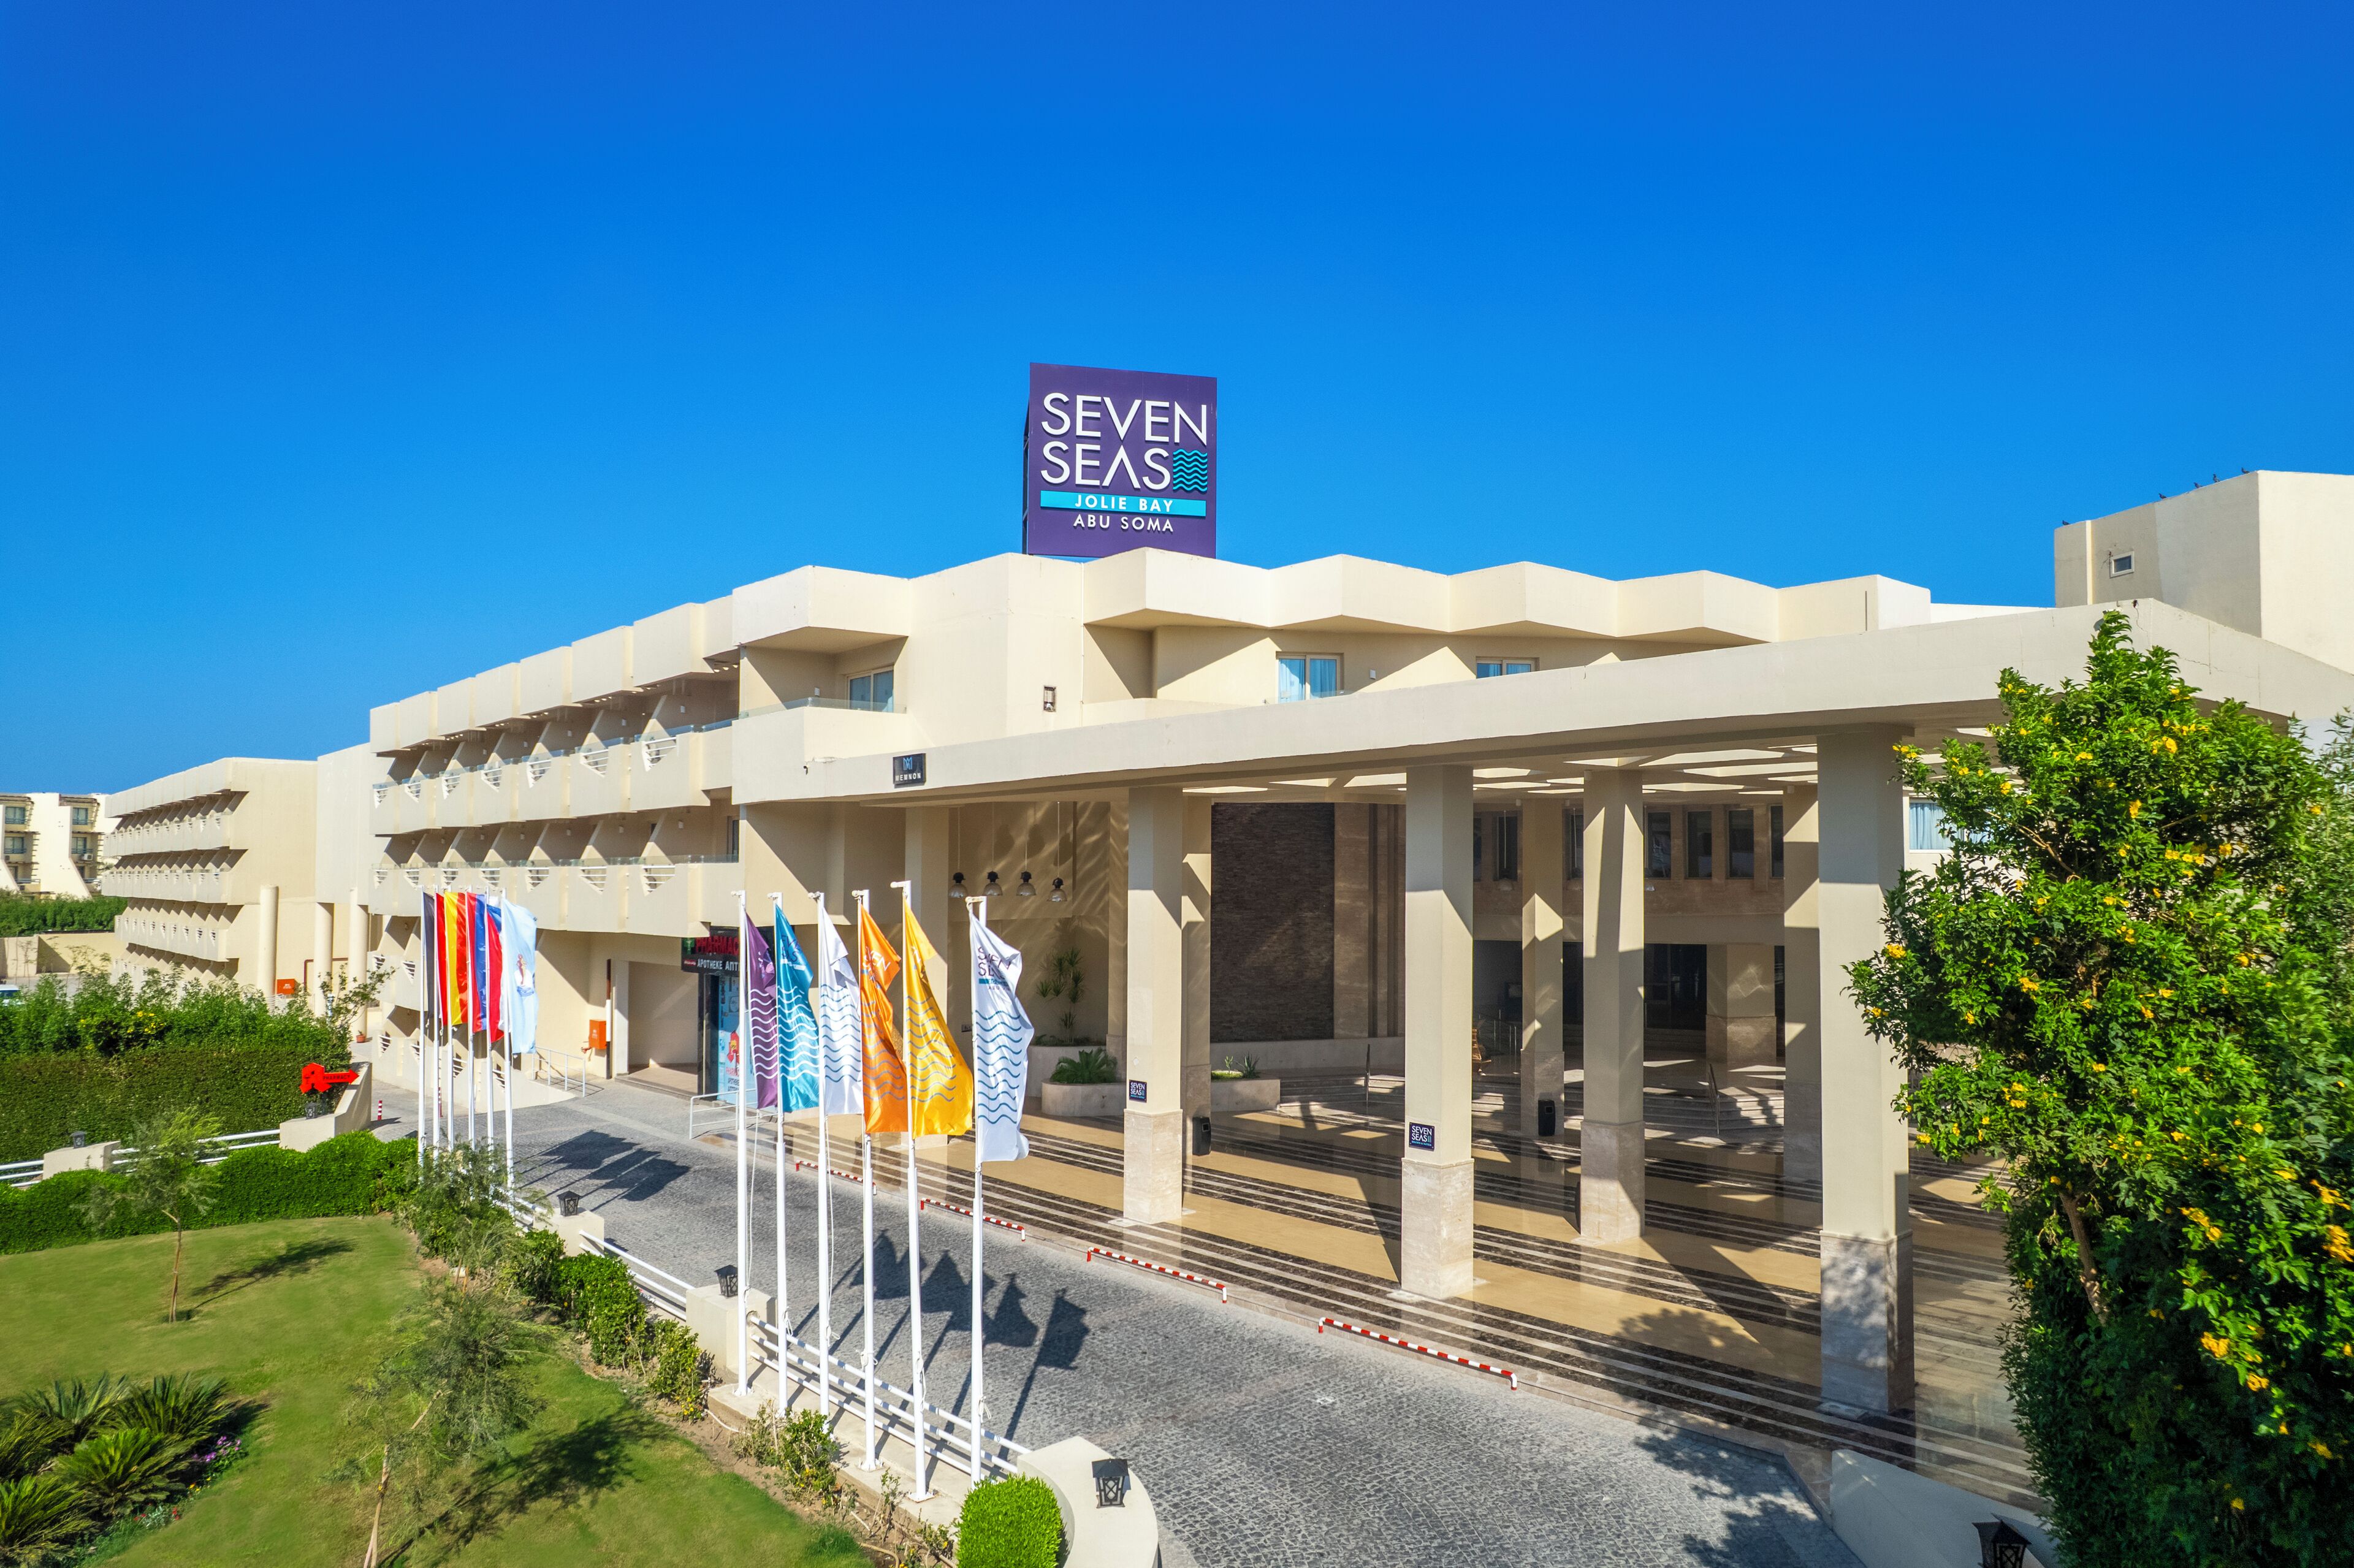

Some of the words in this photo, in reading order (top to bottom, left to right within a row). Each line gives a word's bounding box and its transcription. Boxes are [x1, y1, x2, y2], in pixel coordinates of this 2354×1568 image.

[1042, 392, 1207, 446] SEVEN
[1040, 441, 1171, 490] SEAS
[1075, 495, 1127, 511] JOLIE
[1139, 498, 1173, 512] BAY
[1073, 514, 1110, 529] ABU
[1121, 517, 1173, 532] SOMA
[895, 772, 921, 782] MEMNON
[696, 935, 739, 956] PHARMAC
[697, 959, 723, 970] APOTHEKE
[1411, 1125, 1432, 1136] SEVEN
[1411, 1133, 1428, 1142] SEAS
